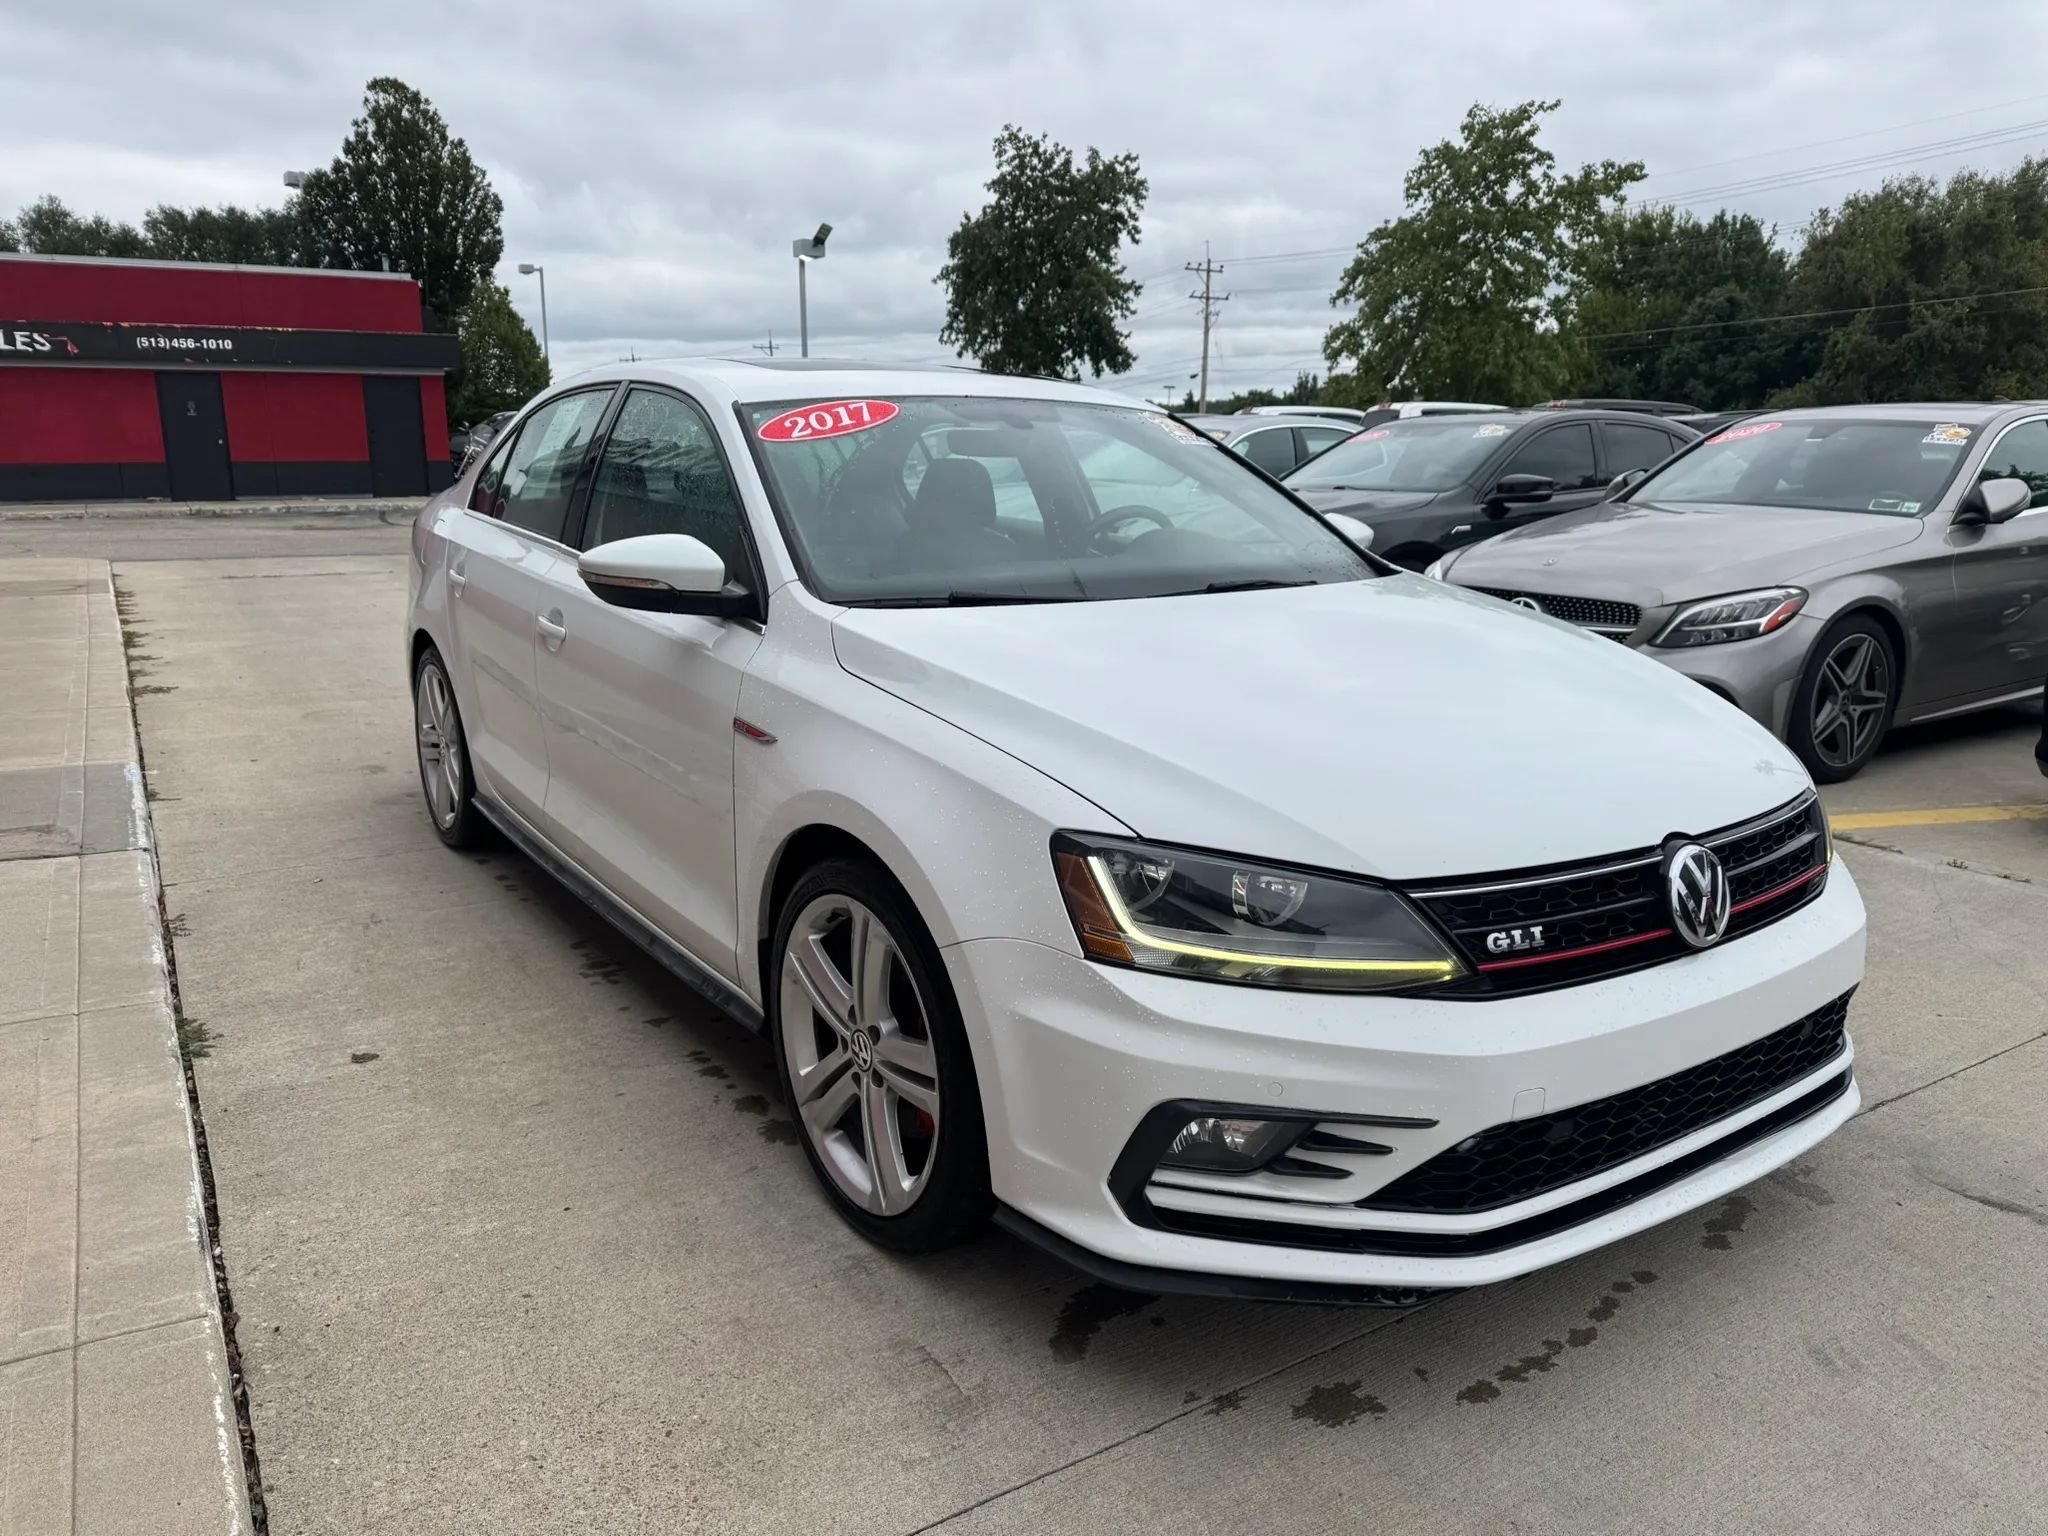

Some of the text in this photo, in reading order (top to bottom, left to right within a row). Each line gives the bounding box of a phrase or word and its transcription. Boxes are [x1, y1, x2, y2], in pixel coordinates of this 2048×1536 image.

[136, 336, 233, 350] (513)456-1010
[784, 402, 872, 438] 2017
[1672, 847, 1727, 944] VW
[1486, 926, 1545, 953] GLI
